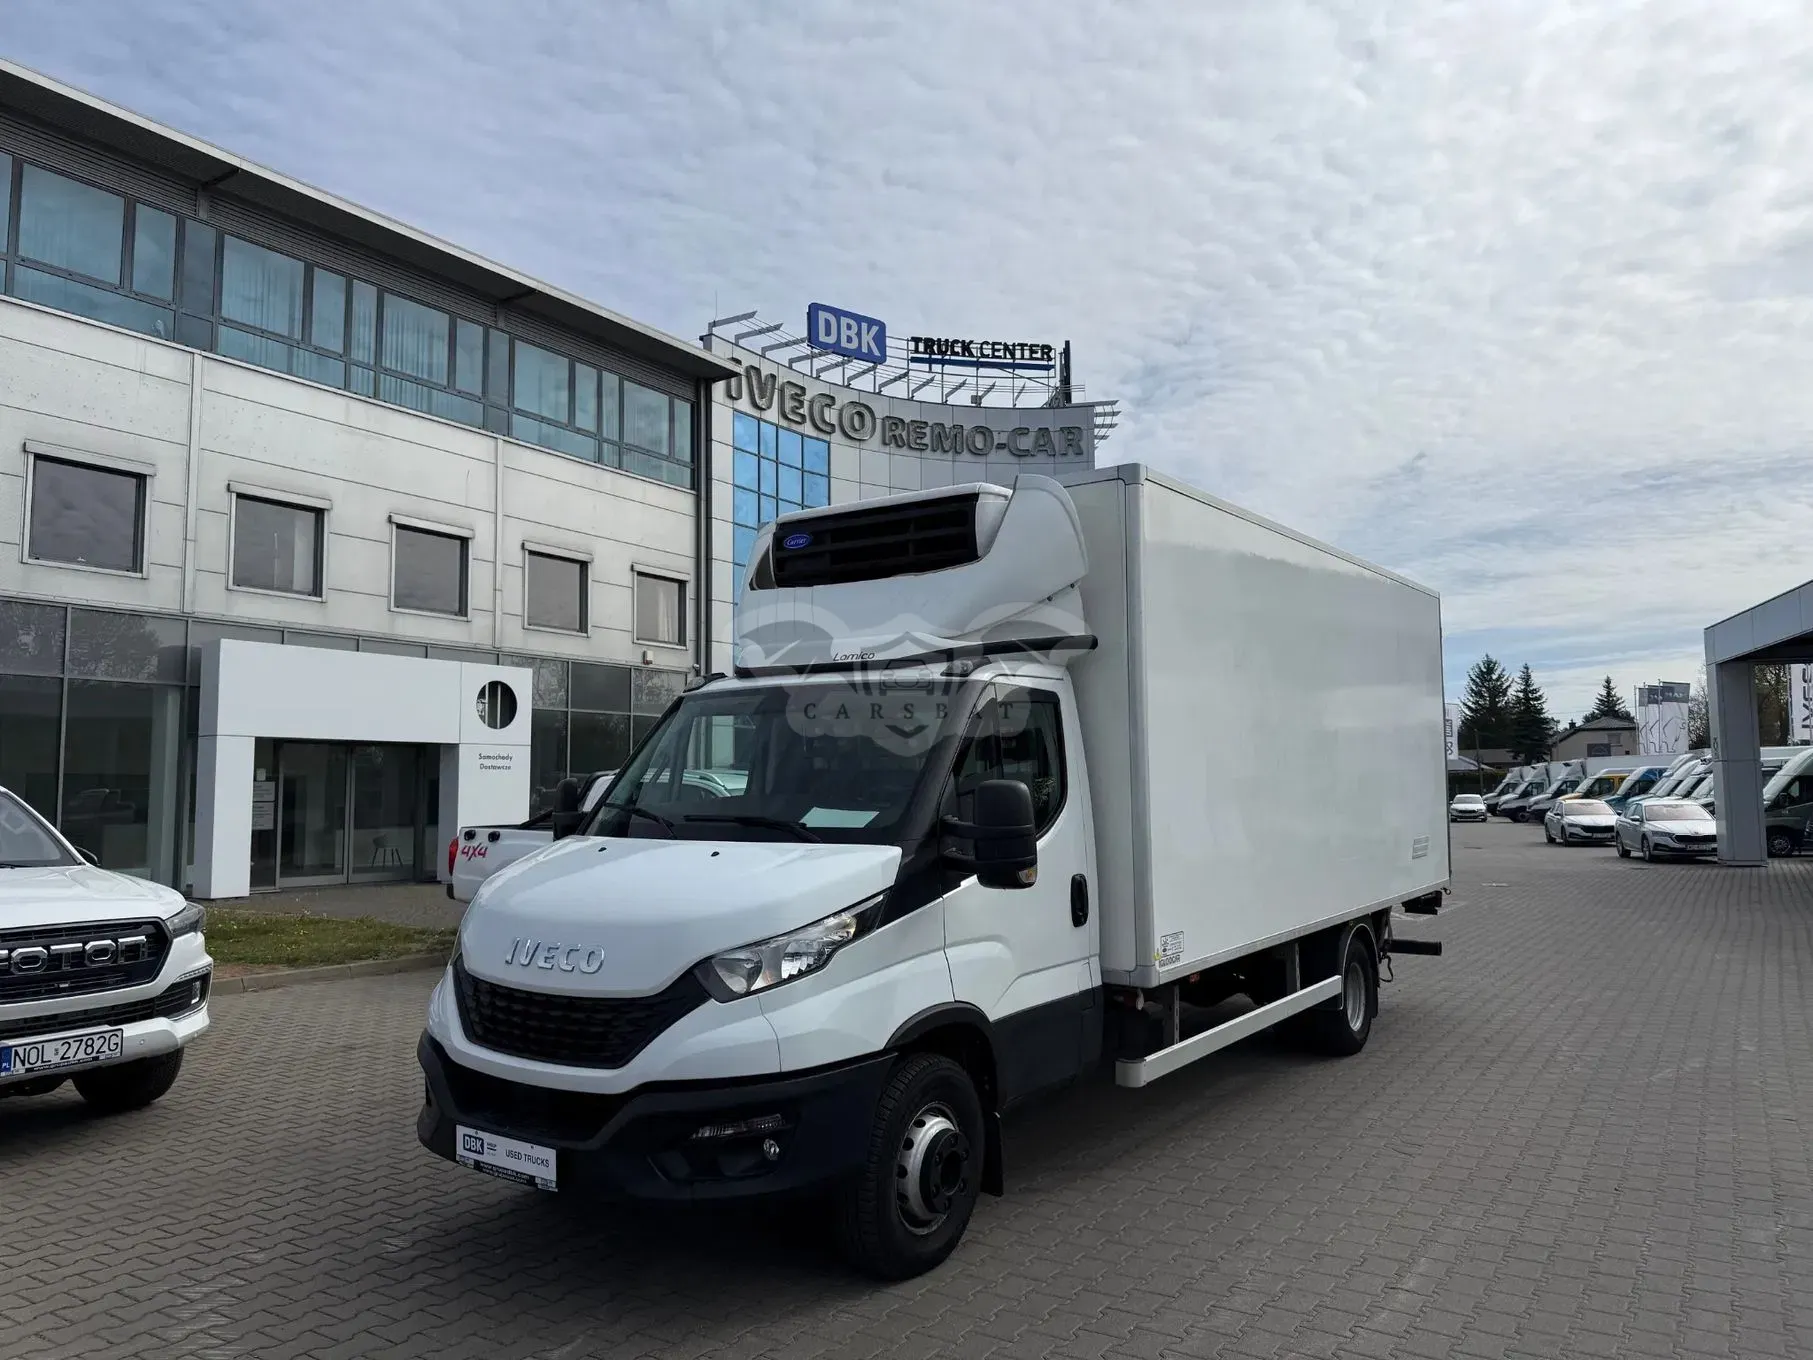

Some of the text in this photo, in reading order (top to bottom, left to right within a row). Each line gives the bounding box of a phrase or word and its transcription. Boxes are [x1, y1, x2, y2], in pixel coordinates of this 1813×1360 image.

[818, 310, 882, 357] DBK
[910, 336, 1053, 361] TRUCK CENTER
[726, 357, 1085, 457] IVECO REMO-CAR
[833, 651, 876, 662] Lamico
[478, 753, 513, 762] Samochody
[479, 763, 512, 771] Dostawcze
[0, 935, 147, 975] OTON
[505, 936, 605, 975] IVECO
[13, 1044, 52, 1069] NOL
[60, 1033, 119, 1061] 2782G
[464, 1136, 483, 1153] DBK
[505, 1149, 522, 1161] USED
[524, 1153, 550, 1168] TRUCKS
